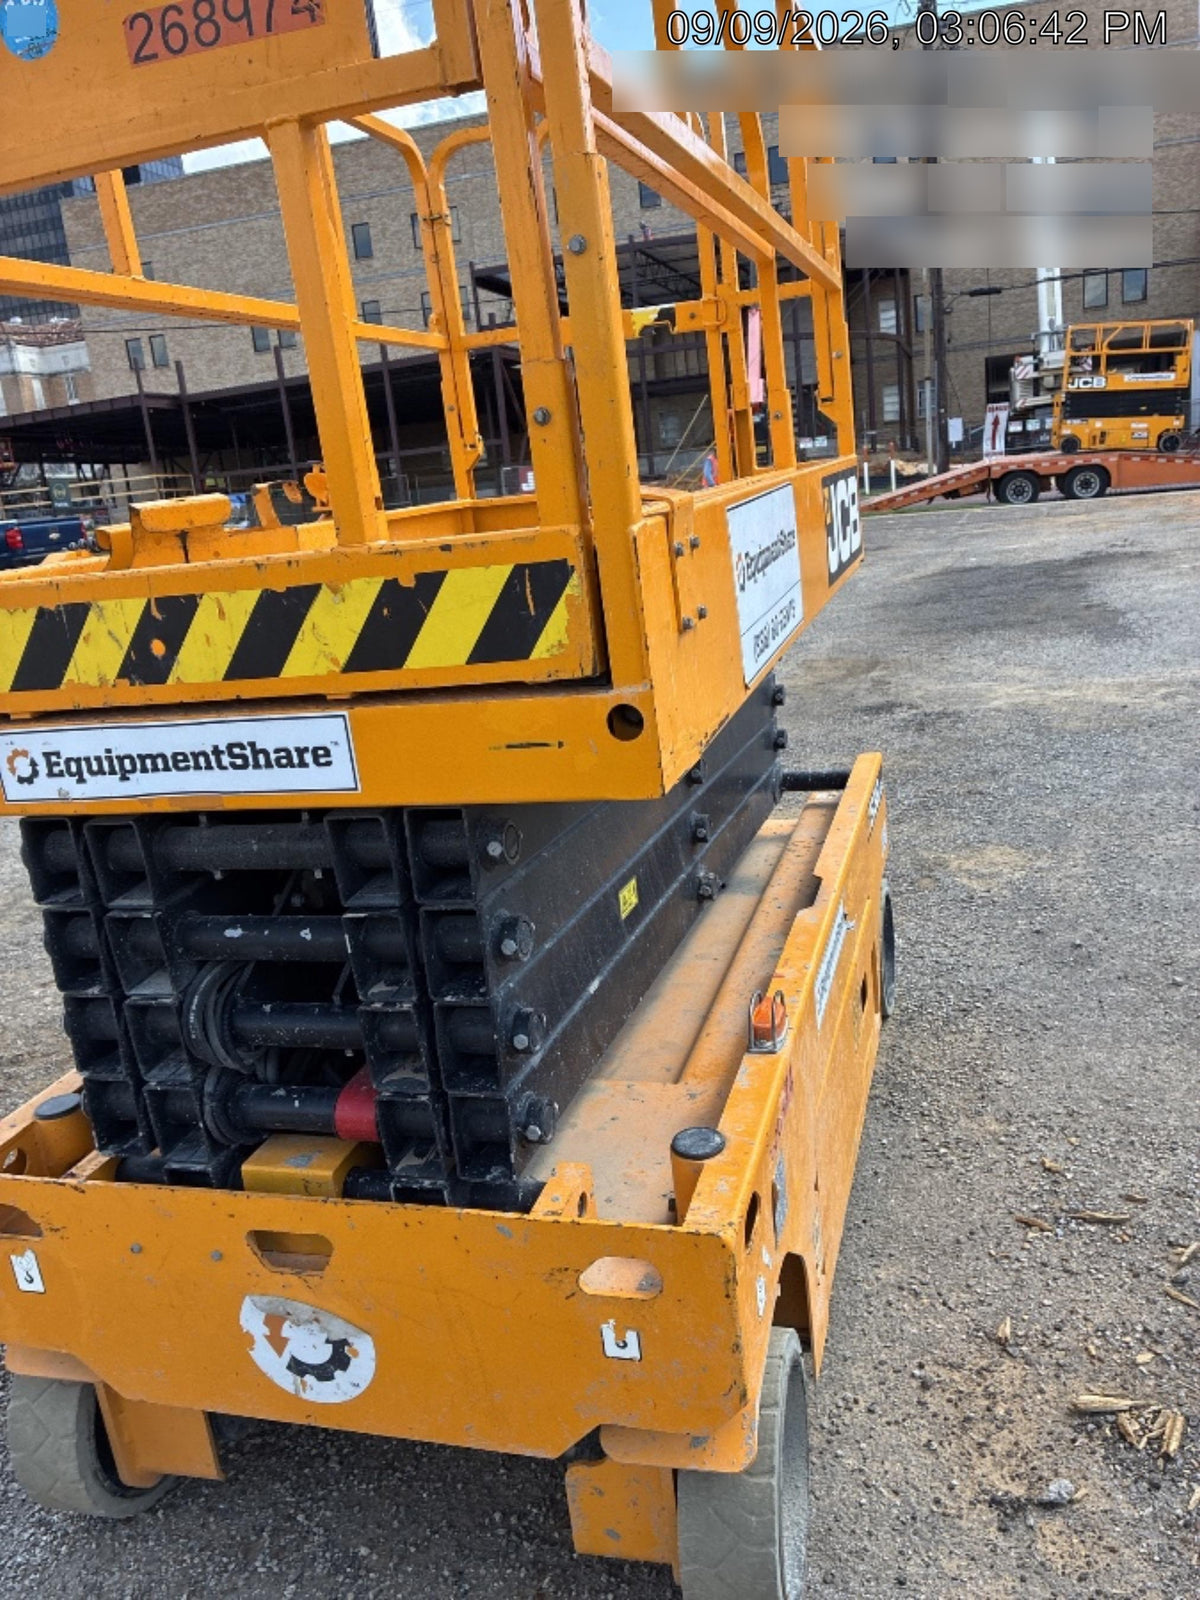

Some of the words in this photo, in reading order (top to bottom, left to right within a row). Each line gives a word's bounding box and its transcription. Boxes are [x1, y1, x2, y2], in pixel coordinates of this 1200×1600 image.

[1068, 377, 1106, 389] JCB
[828, 476, 860, 573] JCB
[42, 741, 333, 784] EquipmentShare
